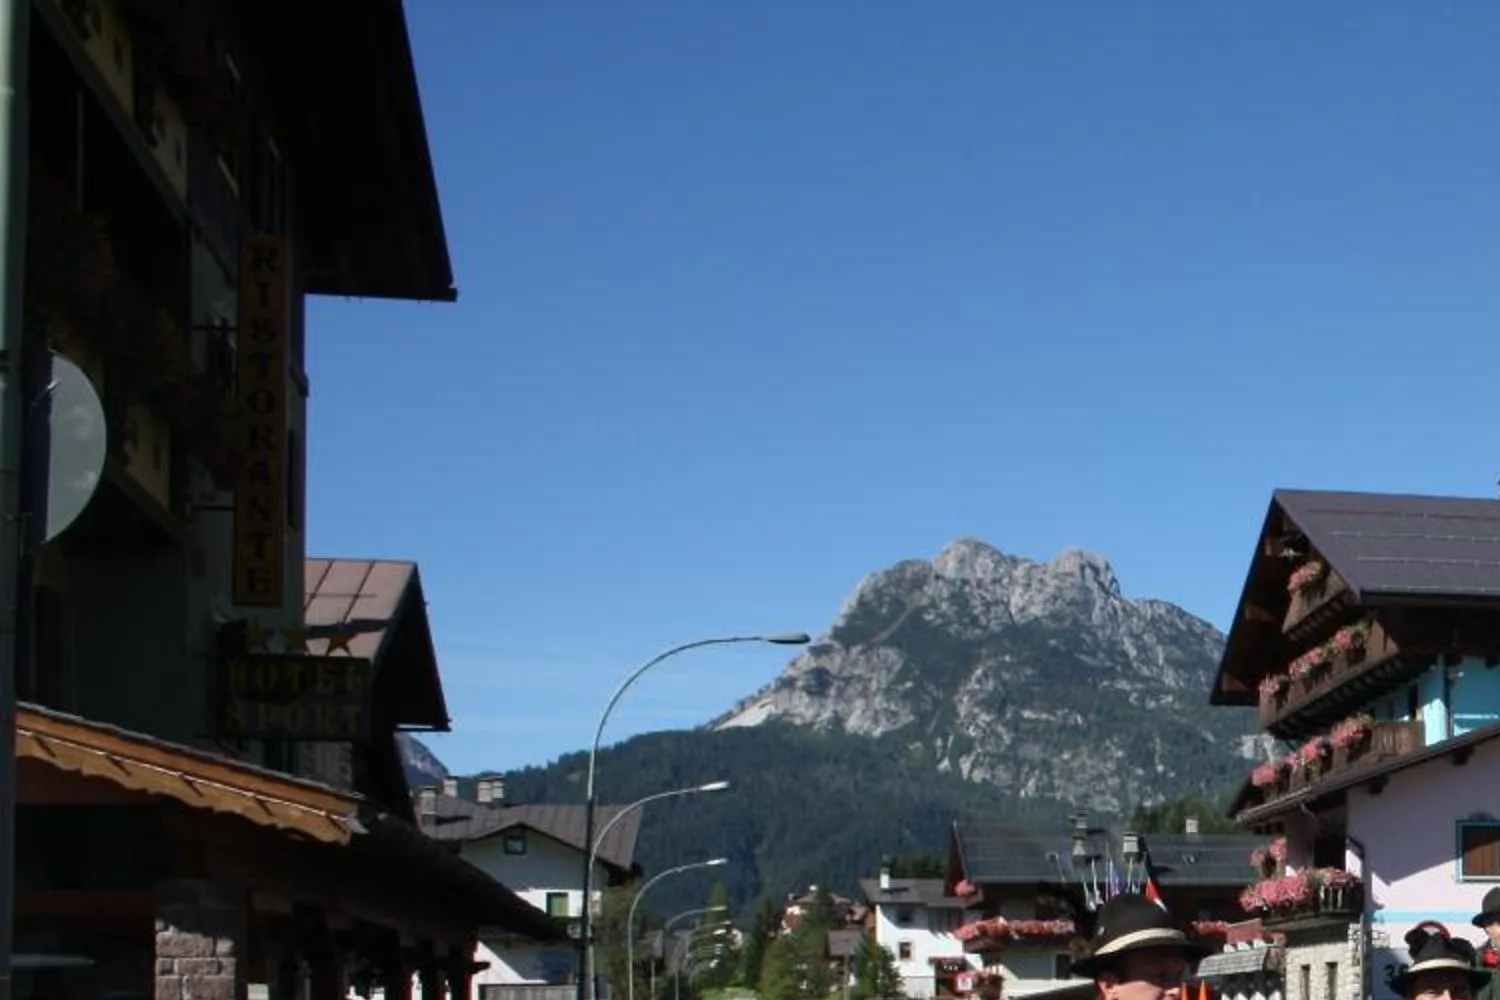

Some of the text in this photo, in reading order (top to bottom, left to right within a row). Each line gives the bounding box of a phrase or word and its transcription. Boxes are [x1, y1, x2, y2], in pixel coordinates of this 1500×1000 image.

[246, 244, 278, 594] RISTORANTE
[228, 659, 363, 693] HOTEL
[225, 699, 362, 734] SPORT
